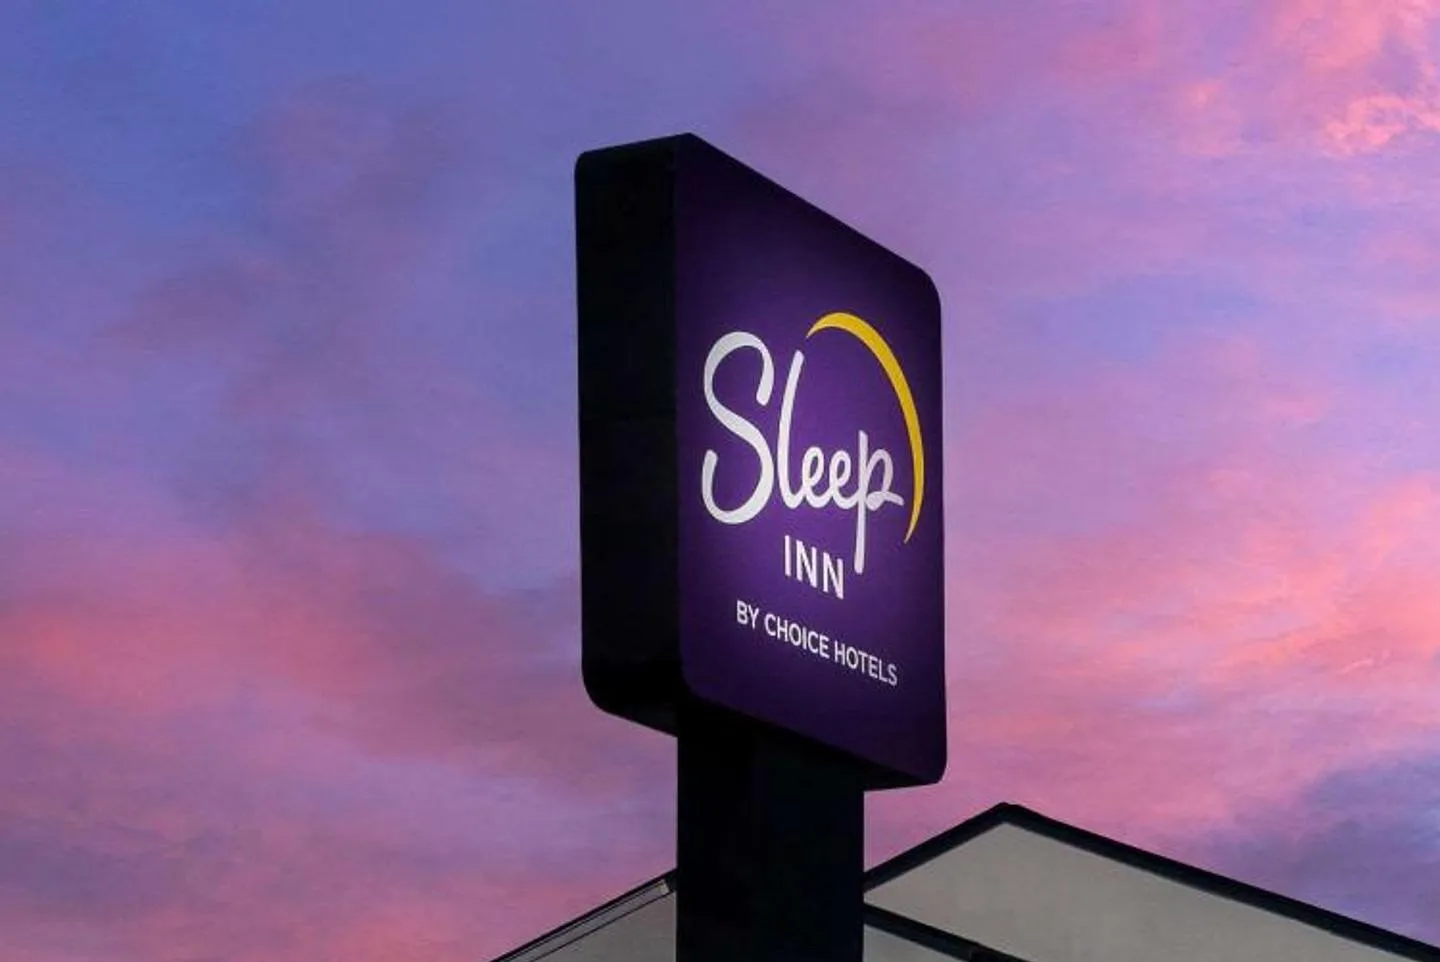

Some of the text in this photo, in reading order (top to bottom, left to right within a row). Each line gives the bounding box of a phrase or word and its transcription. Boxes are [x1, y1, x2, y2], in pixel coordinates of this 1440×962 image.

[702, 331, 904, 574] Sleep
[784, 535, 844, 600] INN
[736, 600, 898, 686] BY CHOICE HOTELS
